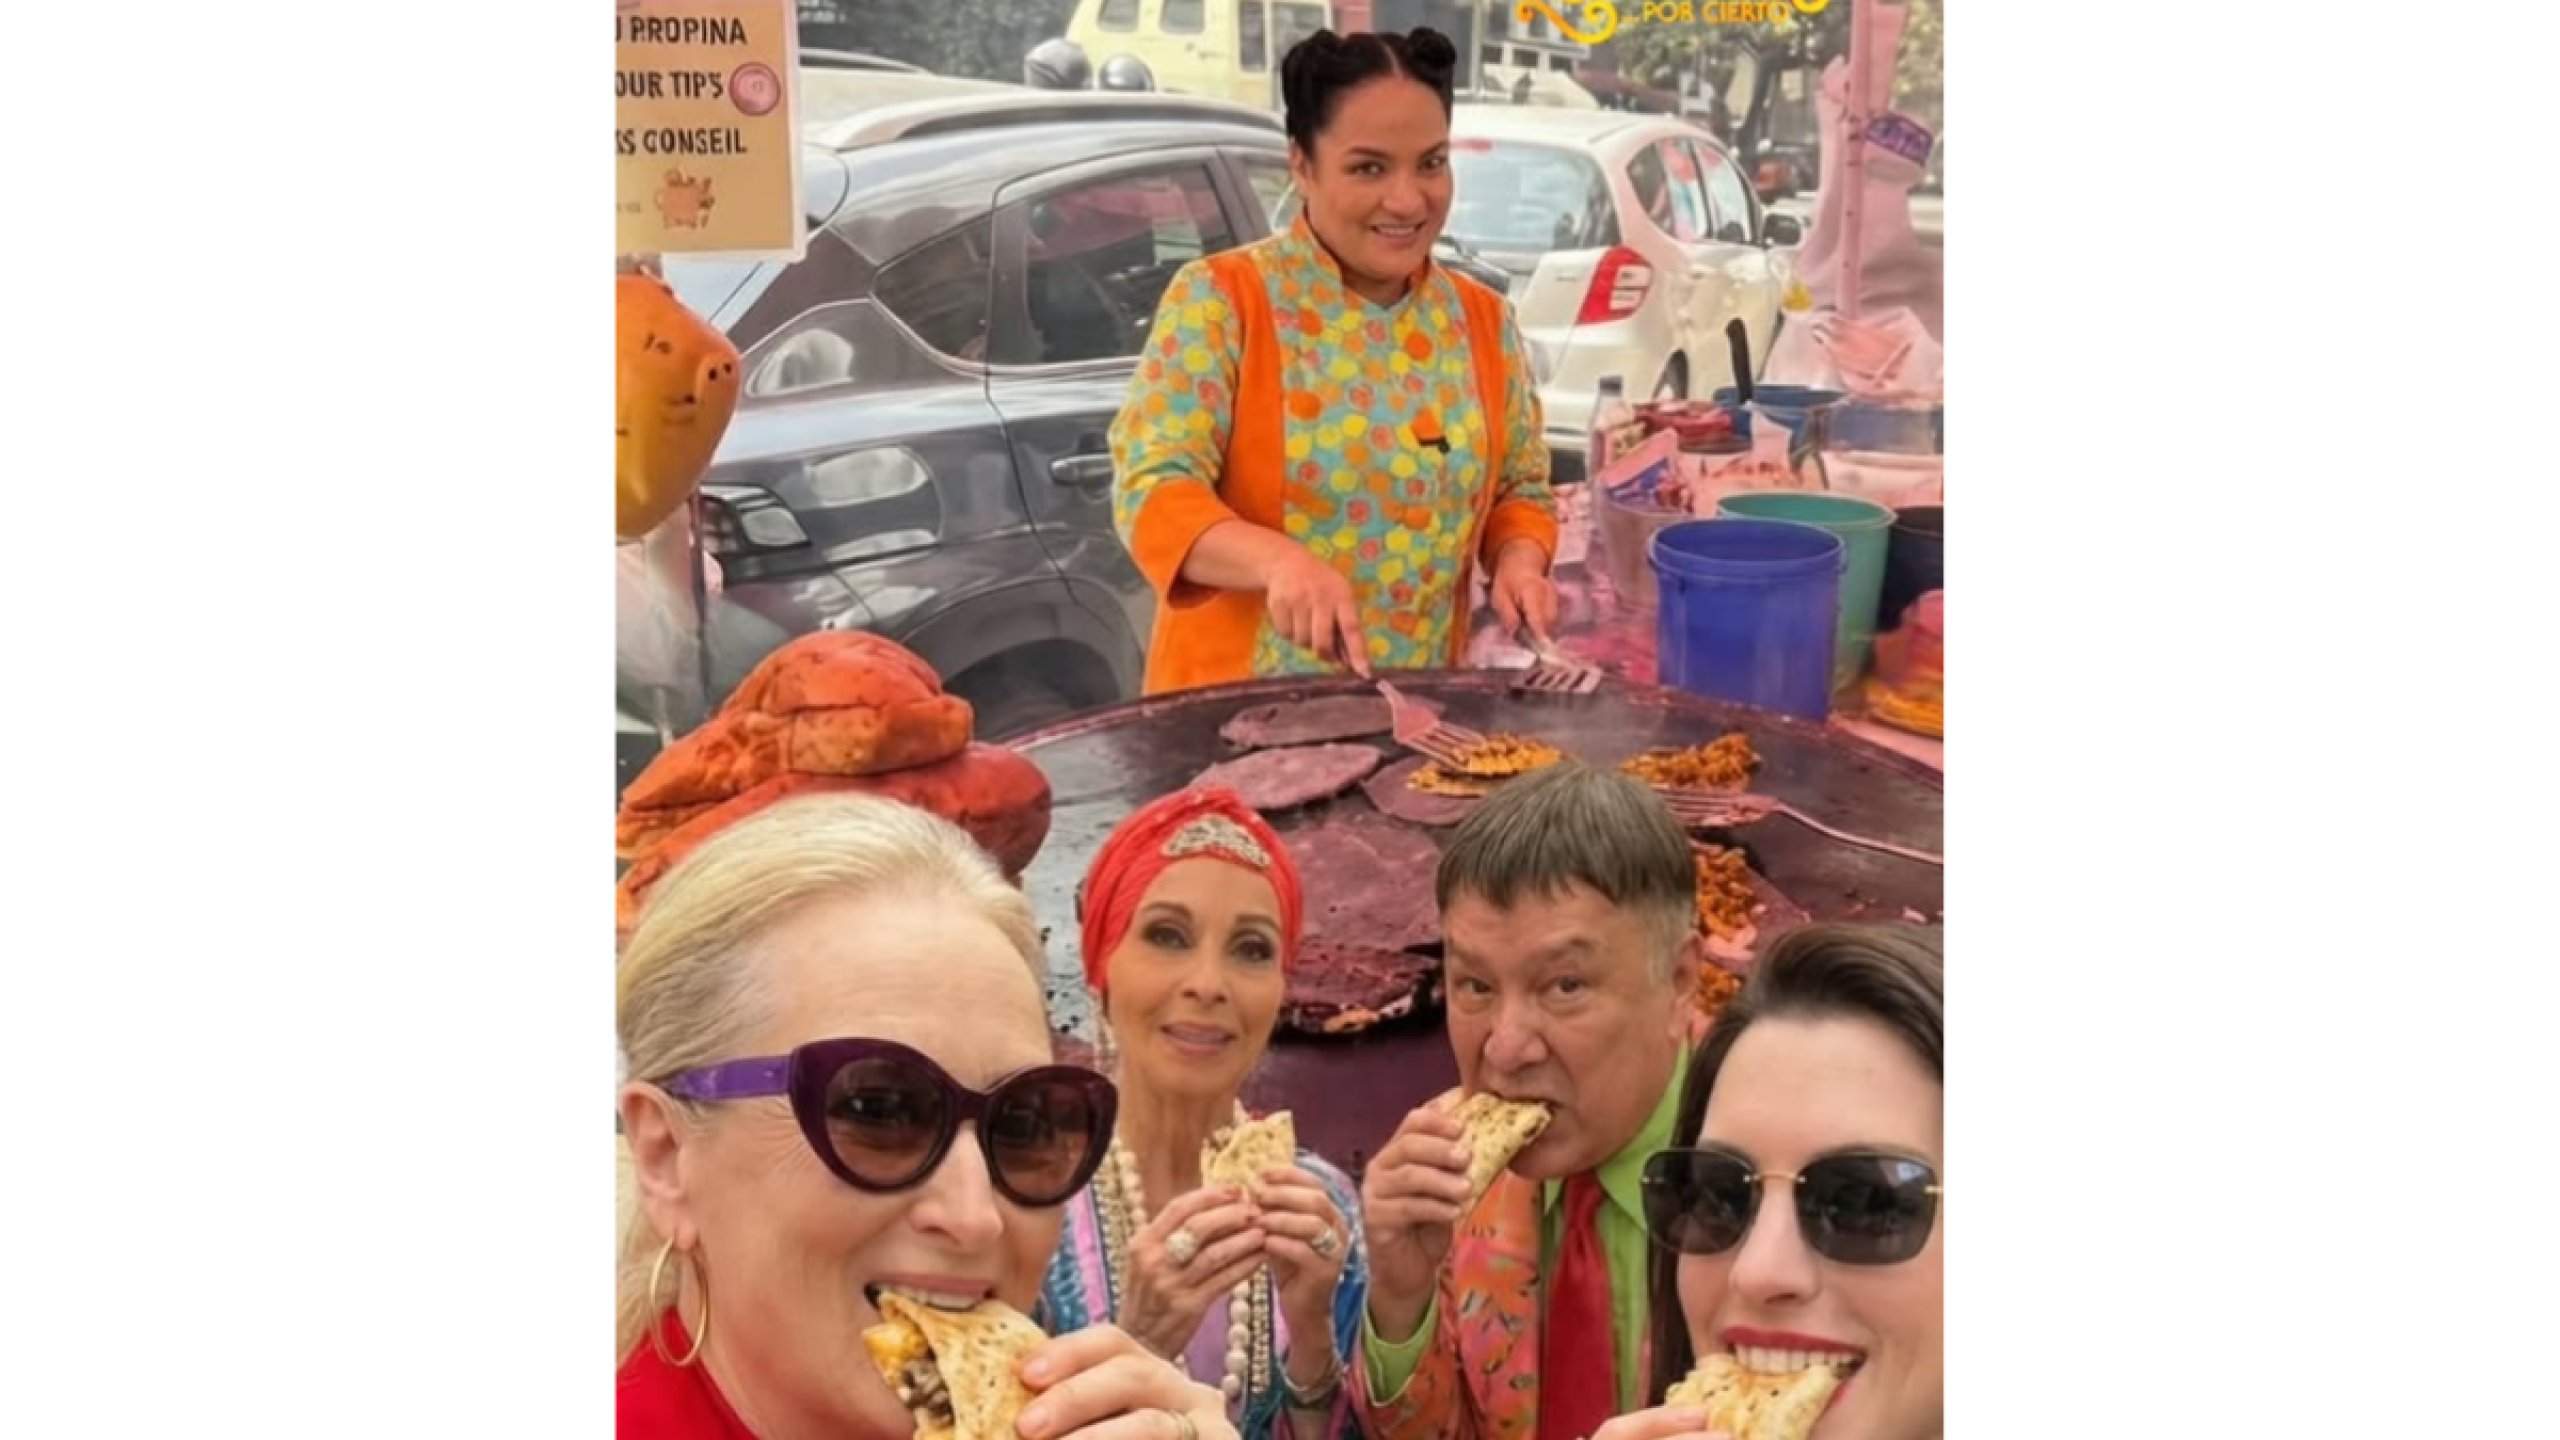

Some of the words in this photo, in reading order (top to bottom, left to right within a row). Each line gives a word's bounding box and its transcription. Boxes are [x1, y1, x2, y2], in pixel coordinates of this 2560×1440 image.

[630, 15, 748, 45] PROPINA
[669, 70, 724, 99] TIPS
[642, 127, 748, 155] CONSEIL
